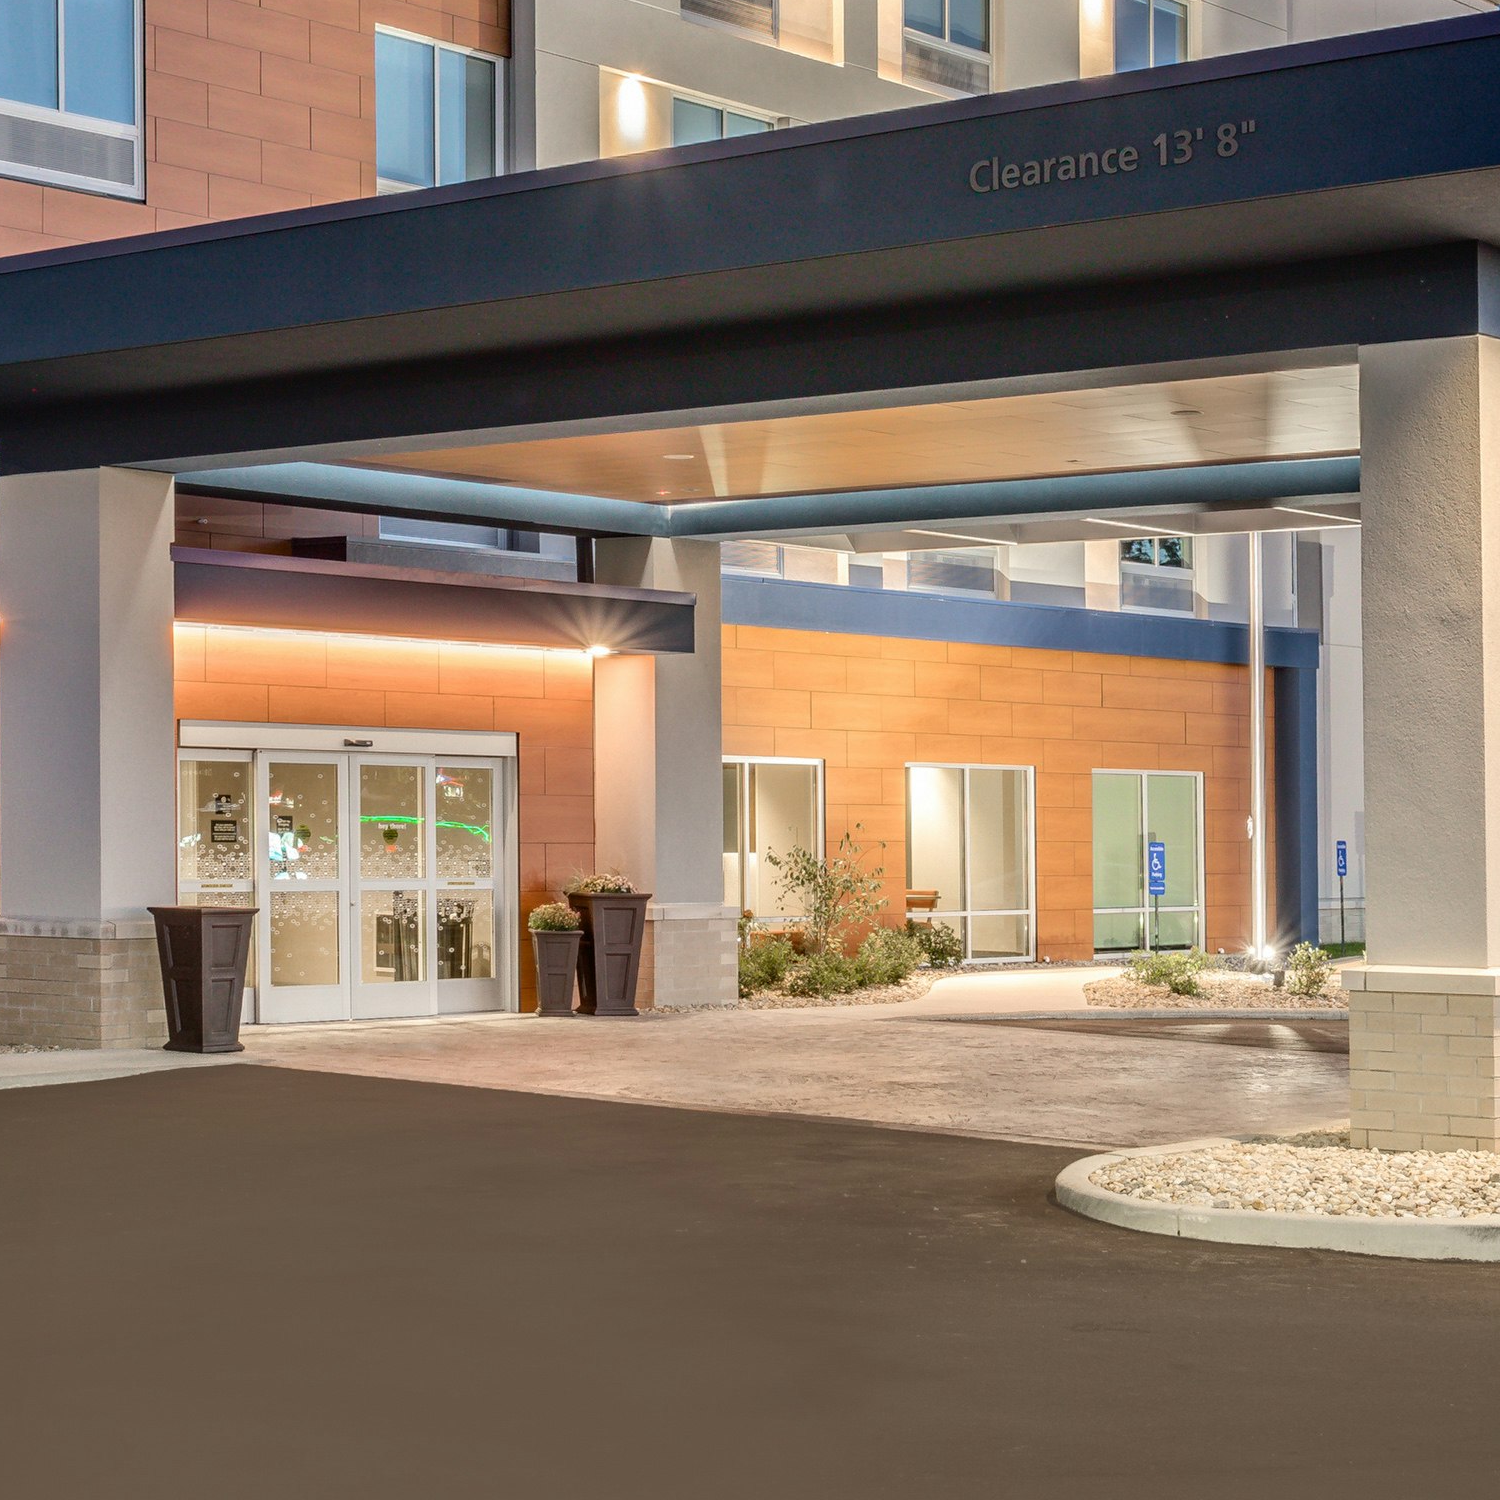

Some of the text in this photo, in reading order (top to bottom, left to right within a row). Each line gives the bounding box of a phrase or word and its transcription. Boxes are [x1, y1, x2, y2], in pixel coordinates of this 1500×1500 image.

[969, 120, 1256, 194] Clearance 13' 8"
